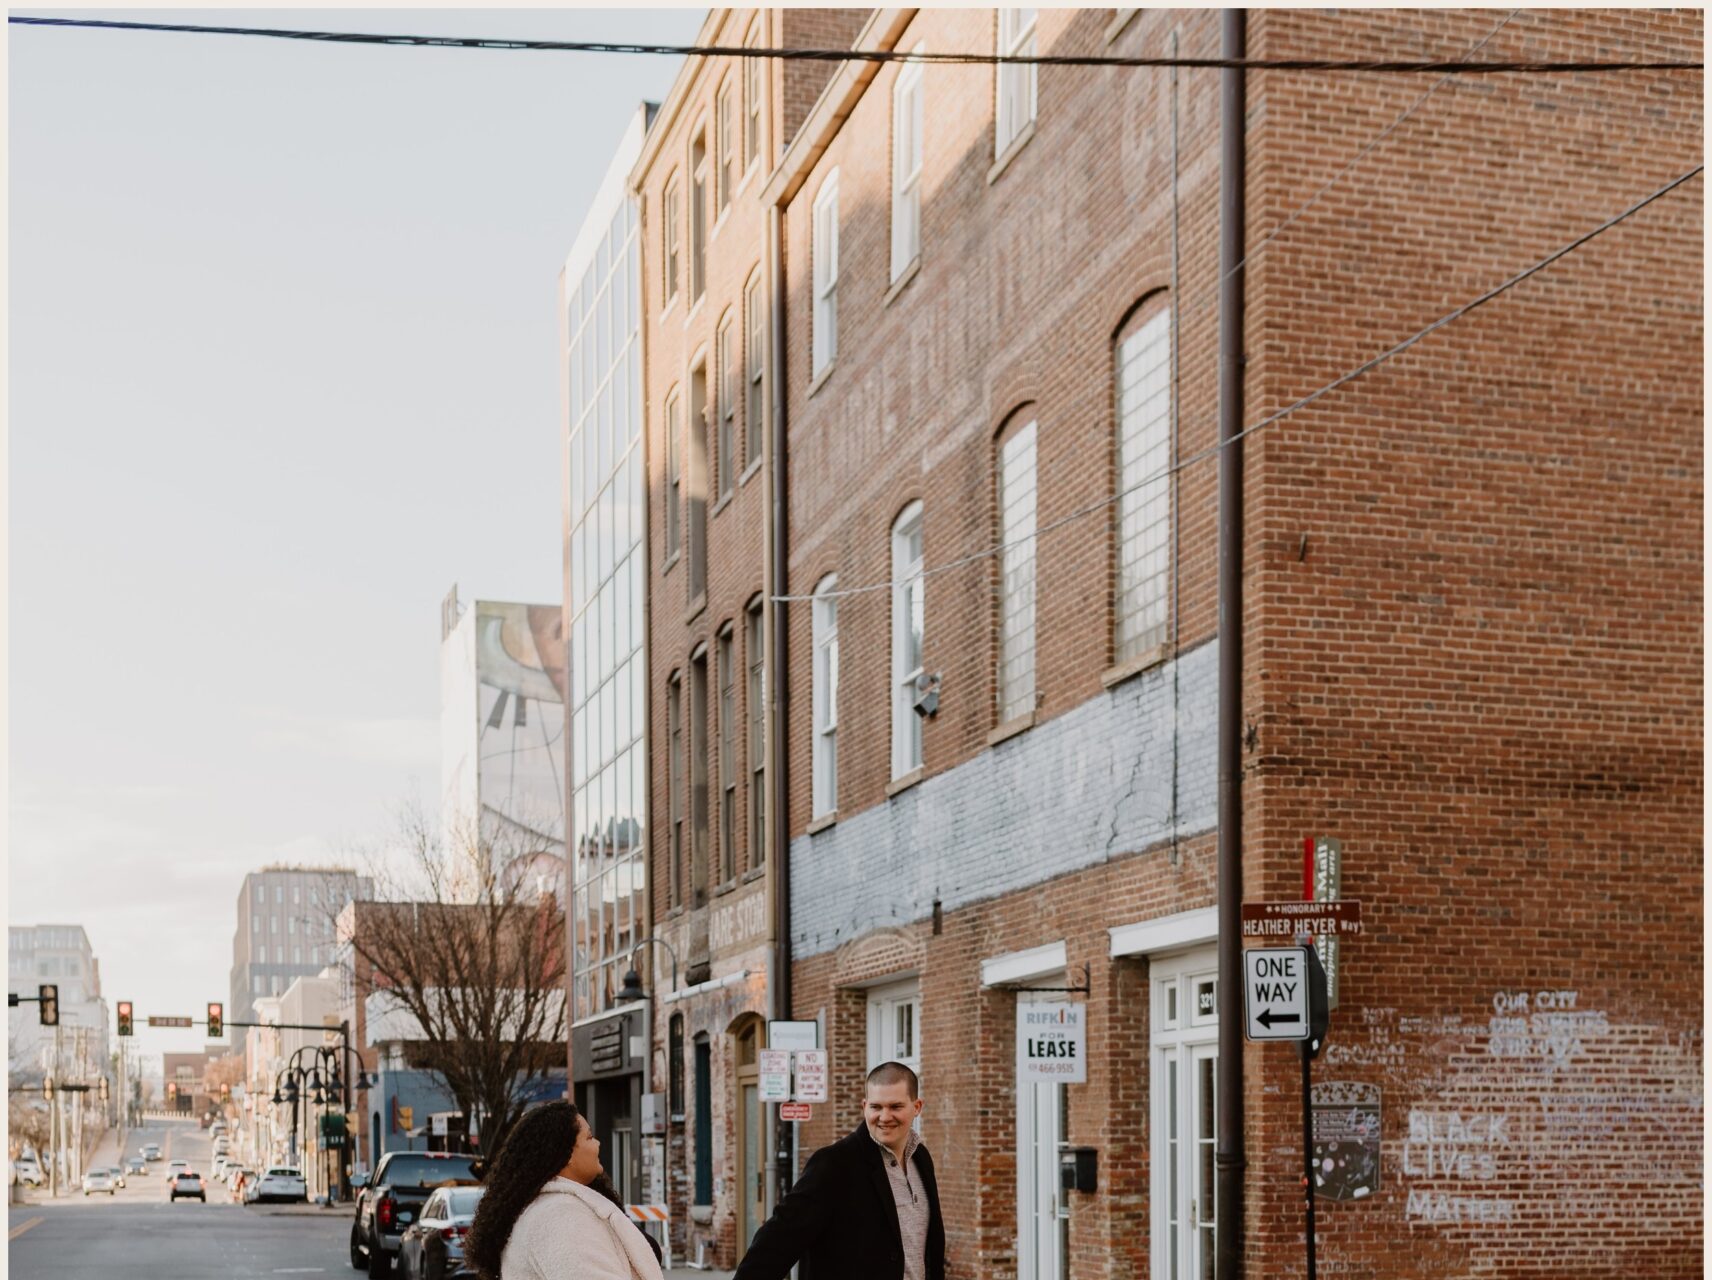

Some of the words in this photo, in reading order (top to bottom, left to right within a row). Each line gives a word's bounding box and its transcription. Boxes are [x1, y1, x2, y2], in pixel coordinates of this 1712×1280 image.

[1317, 844, 1328, 892] Mall
[1281, 904, 1325, 913] HONORARY
[1243, 919, 1291, 935] HEATHER
[1294, 918, 1336, 934] HEYER
[1341, 921, 1359, 934] Way
[1255, 957, 1296, 977] ONE
[1200, 993, 1213, 1008] 321
[1255, 982, 1297, 1002] WAY
[1493, 991, 1529, 1011] OUR
[1535, 991, 1578, 1008] CITY
[1026, 1008, 1077, 1024] RIFKIN
[805, 1053, 817, 1062] NO
[1028, 1038, 1076, 1057] LEASE
[1409, 1110, 1512, 1148] BLACK
[1404, 1142, 1496, 1179] LIVES
[1405, 1188, 1514, 1222] MATTER
